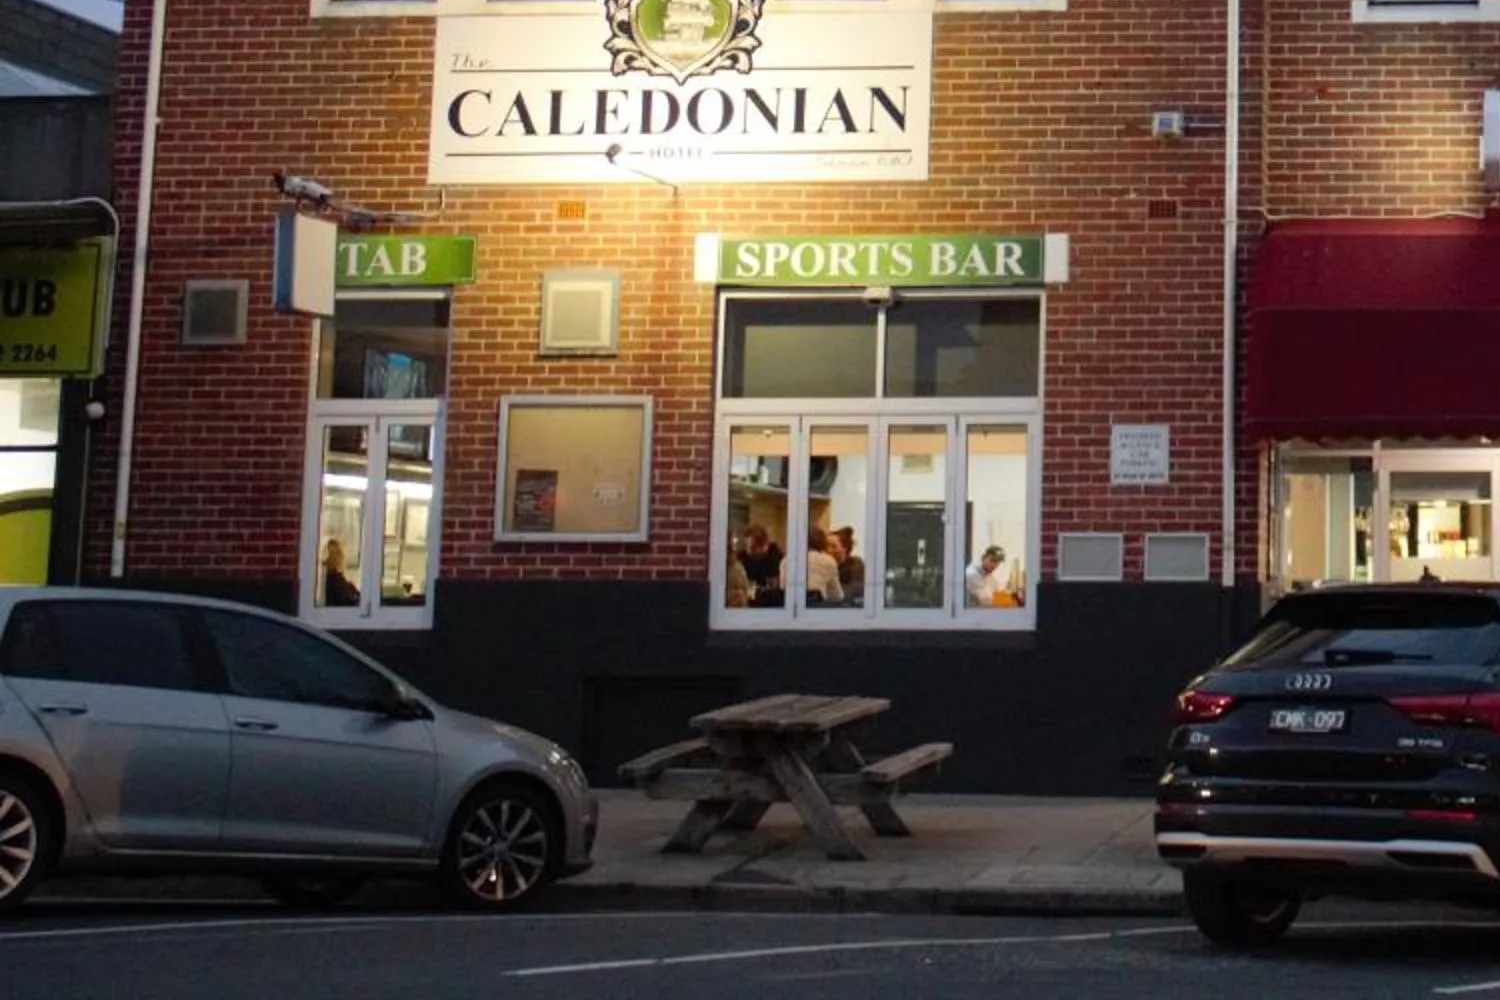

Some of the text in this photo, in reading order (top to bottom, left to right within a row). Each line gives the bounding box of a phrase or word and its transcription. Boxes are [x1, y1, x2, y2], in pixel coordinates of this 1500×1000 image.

[447, 86, 909, 138] CALEDONIAN
[339, 241, 427, 277] TAB
[735, 241, 1025, 278] SPORTS BAR
[11, 343, 57, 363] 2264
